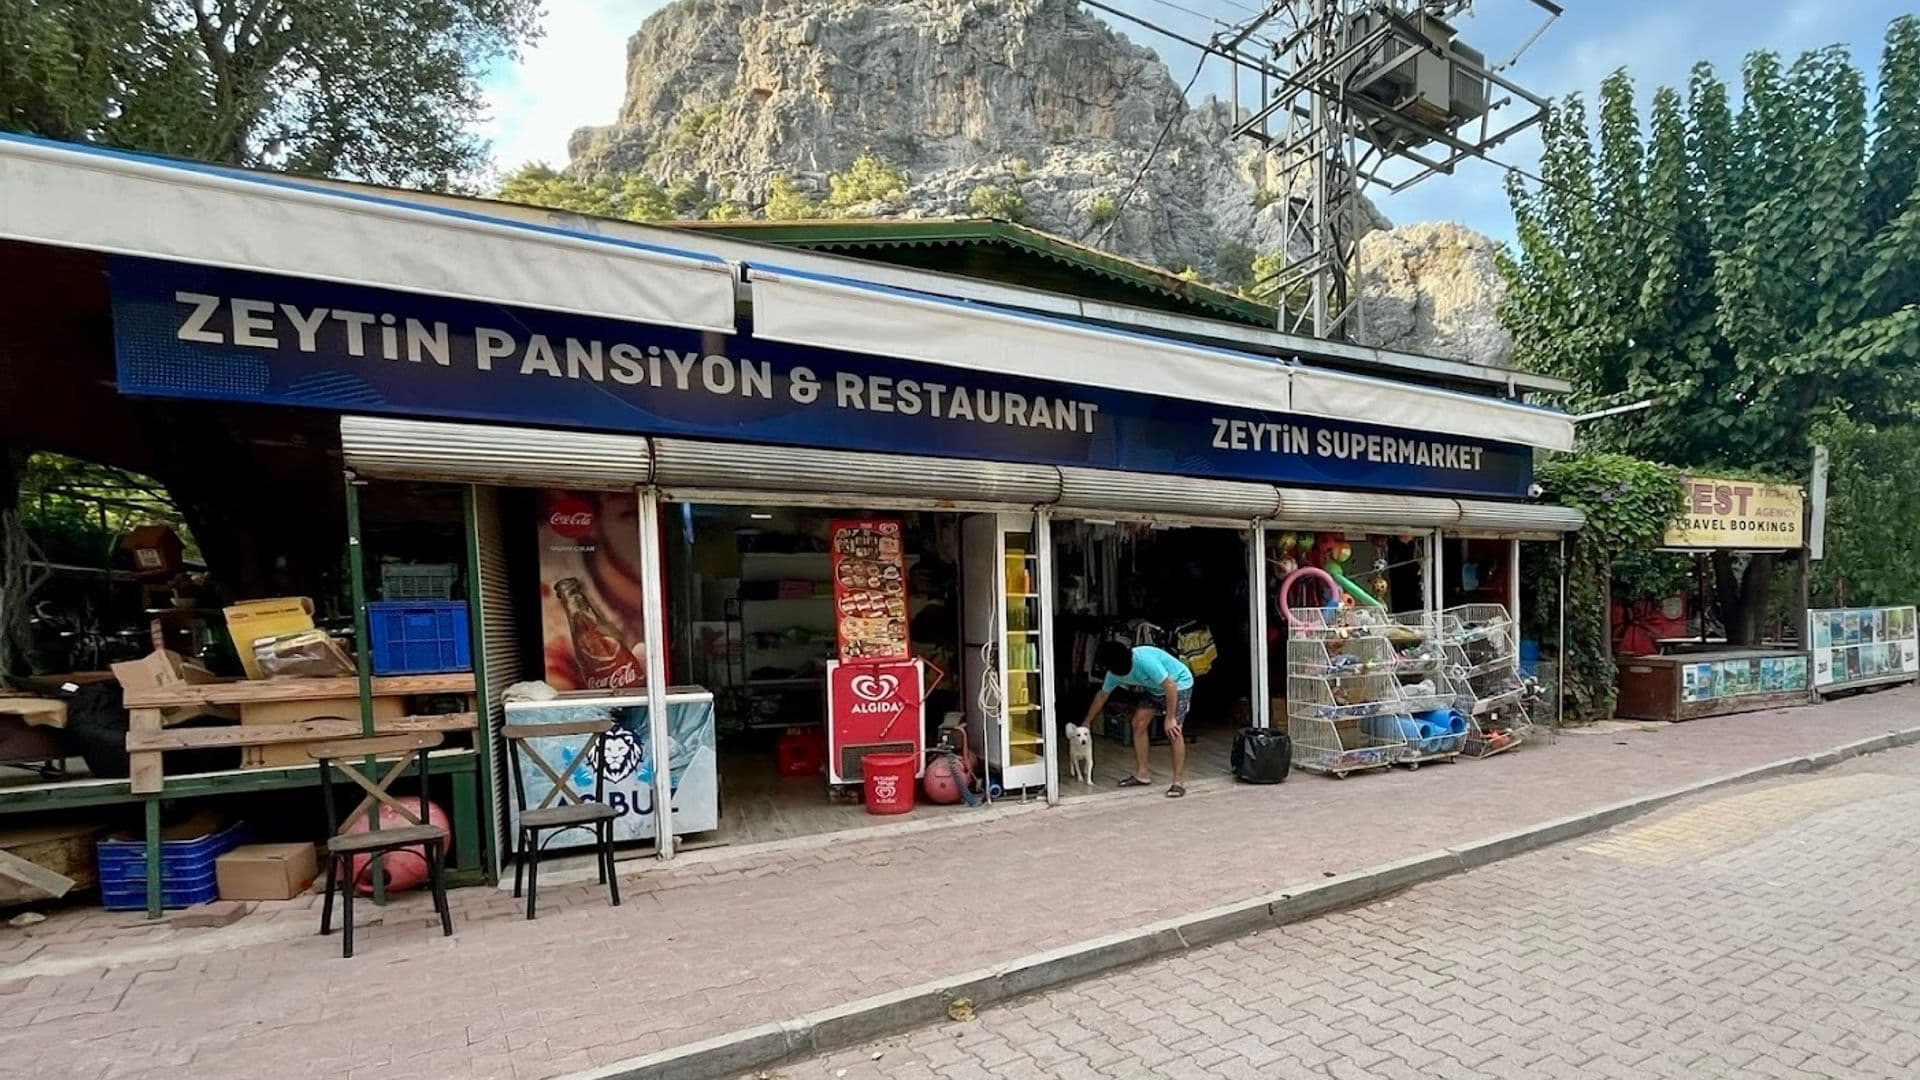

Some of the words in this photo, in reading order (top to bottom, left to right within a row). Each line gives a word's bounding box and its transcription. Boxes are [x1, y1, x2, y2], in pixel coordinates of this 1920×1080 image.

[788, 366, 821, 404] &
[836, 371, 1099, 434] RESTAURANT
[1316, 428, 1484, 472] SUPERMARKET
[1687, 483, 1754, 516] EST
[1755, 507, 1798, 518] AGENCY
[1730, 520, 1796, 533] BOOKINGS
[851, 701, 900, 714] ALGIDA
